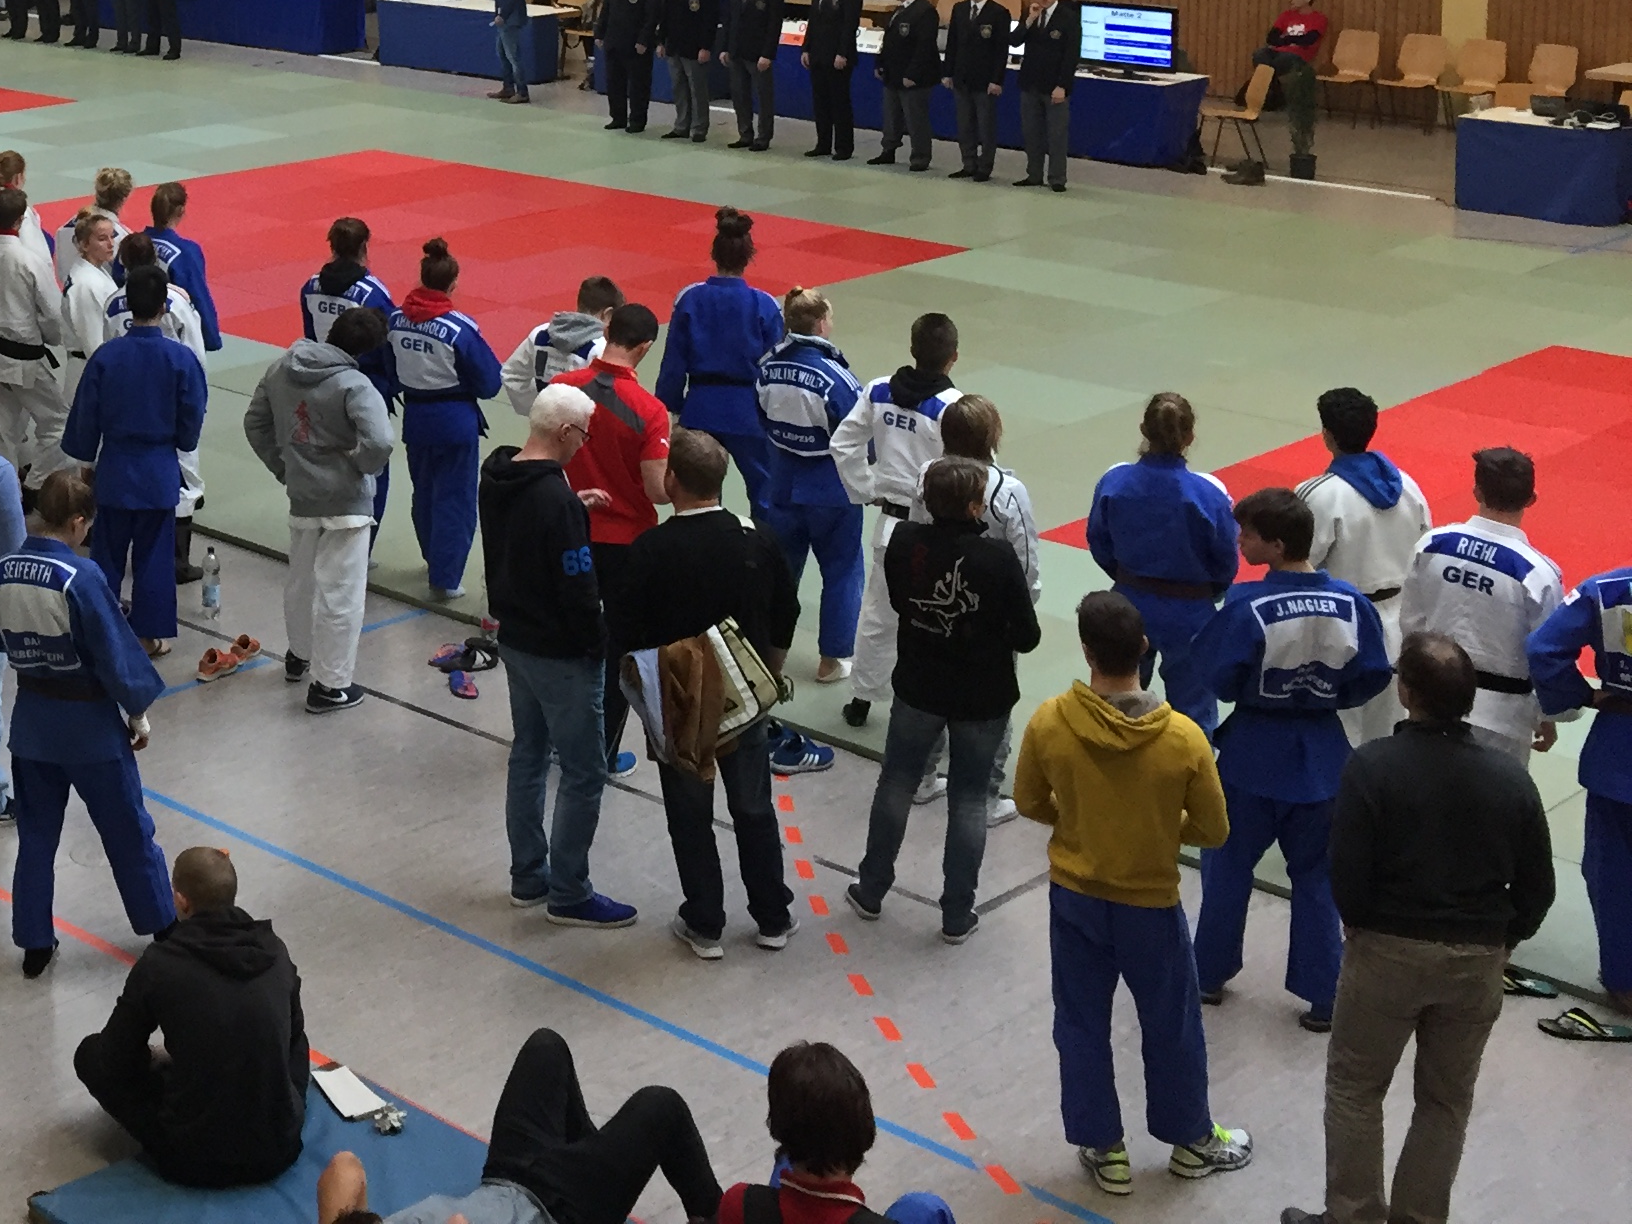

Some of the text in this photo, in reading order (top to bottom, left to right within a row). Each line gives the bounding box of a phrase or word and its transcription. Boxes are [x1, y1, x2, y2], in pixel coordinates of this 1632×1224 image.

[400, 336, 435, 355] GER
[883, 411, 917, 434] GER
[1456, 536, 1498, 565] RIEHL
[2, 560, 53, 584] SEIFERTH
[1442, 565, 1495, 597] GER
